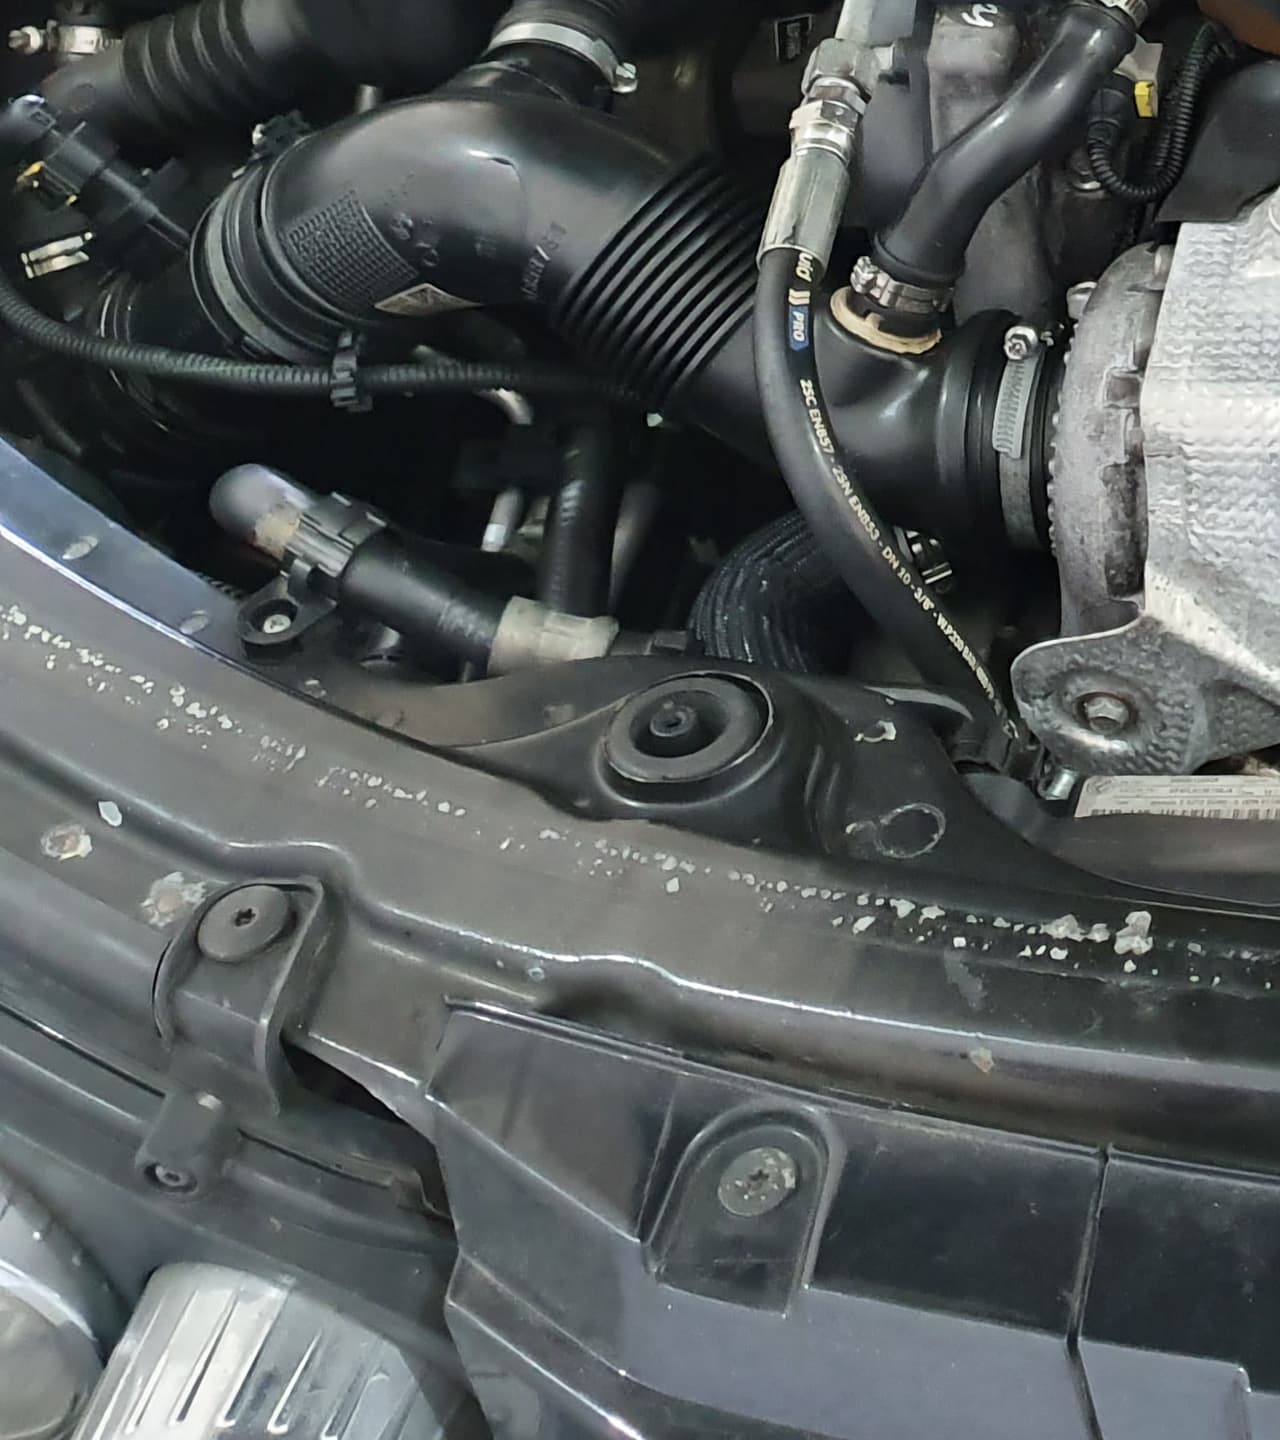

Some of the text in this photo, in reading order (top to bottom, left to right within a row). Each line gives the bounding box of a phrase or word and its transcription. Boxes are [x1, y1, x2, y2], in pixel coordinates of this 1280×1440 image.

[792, 310, 805, 342] PRO
[800, 378, 818, 408] 2SC
[832, 465, 854, 497] 2SN
[882, 545, 900, 570] DN
[897, 566, 912, 587] 10
